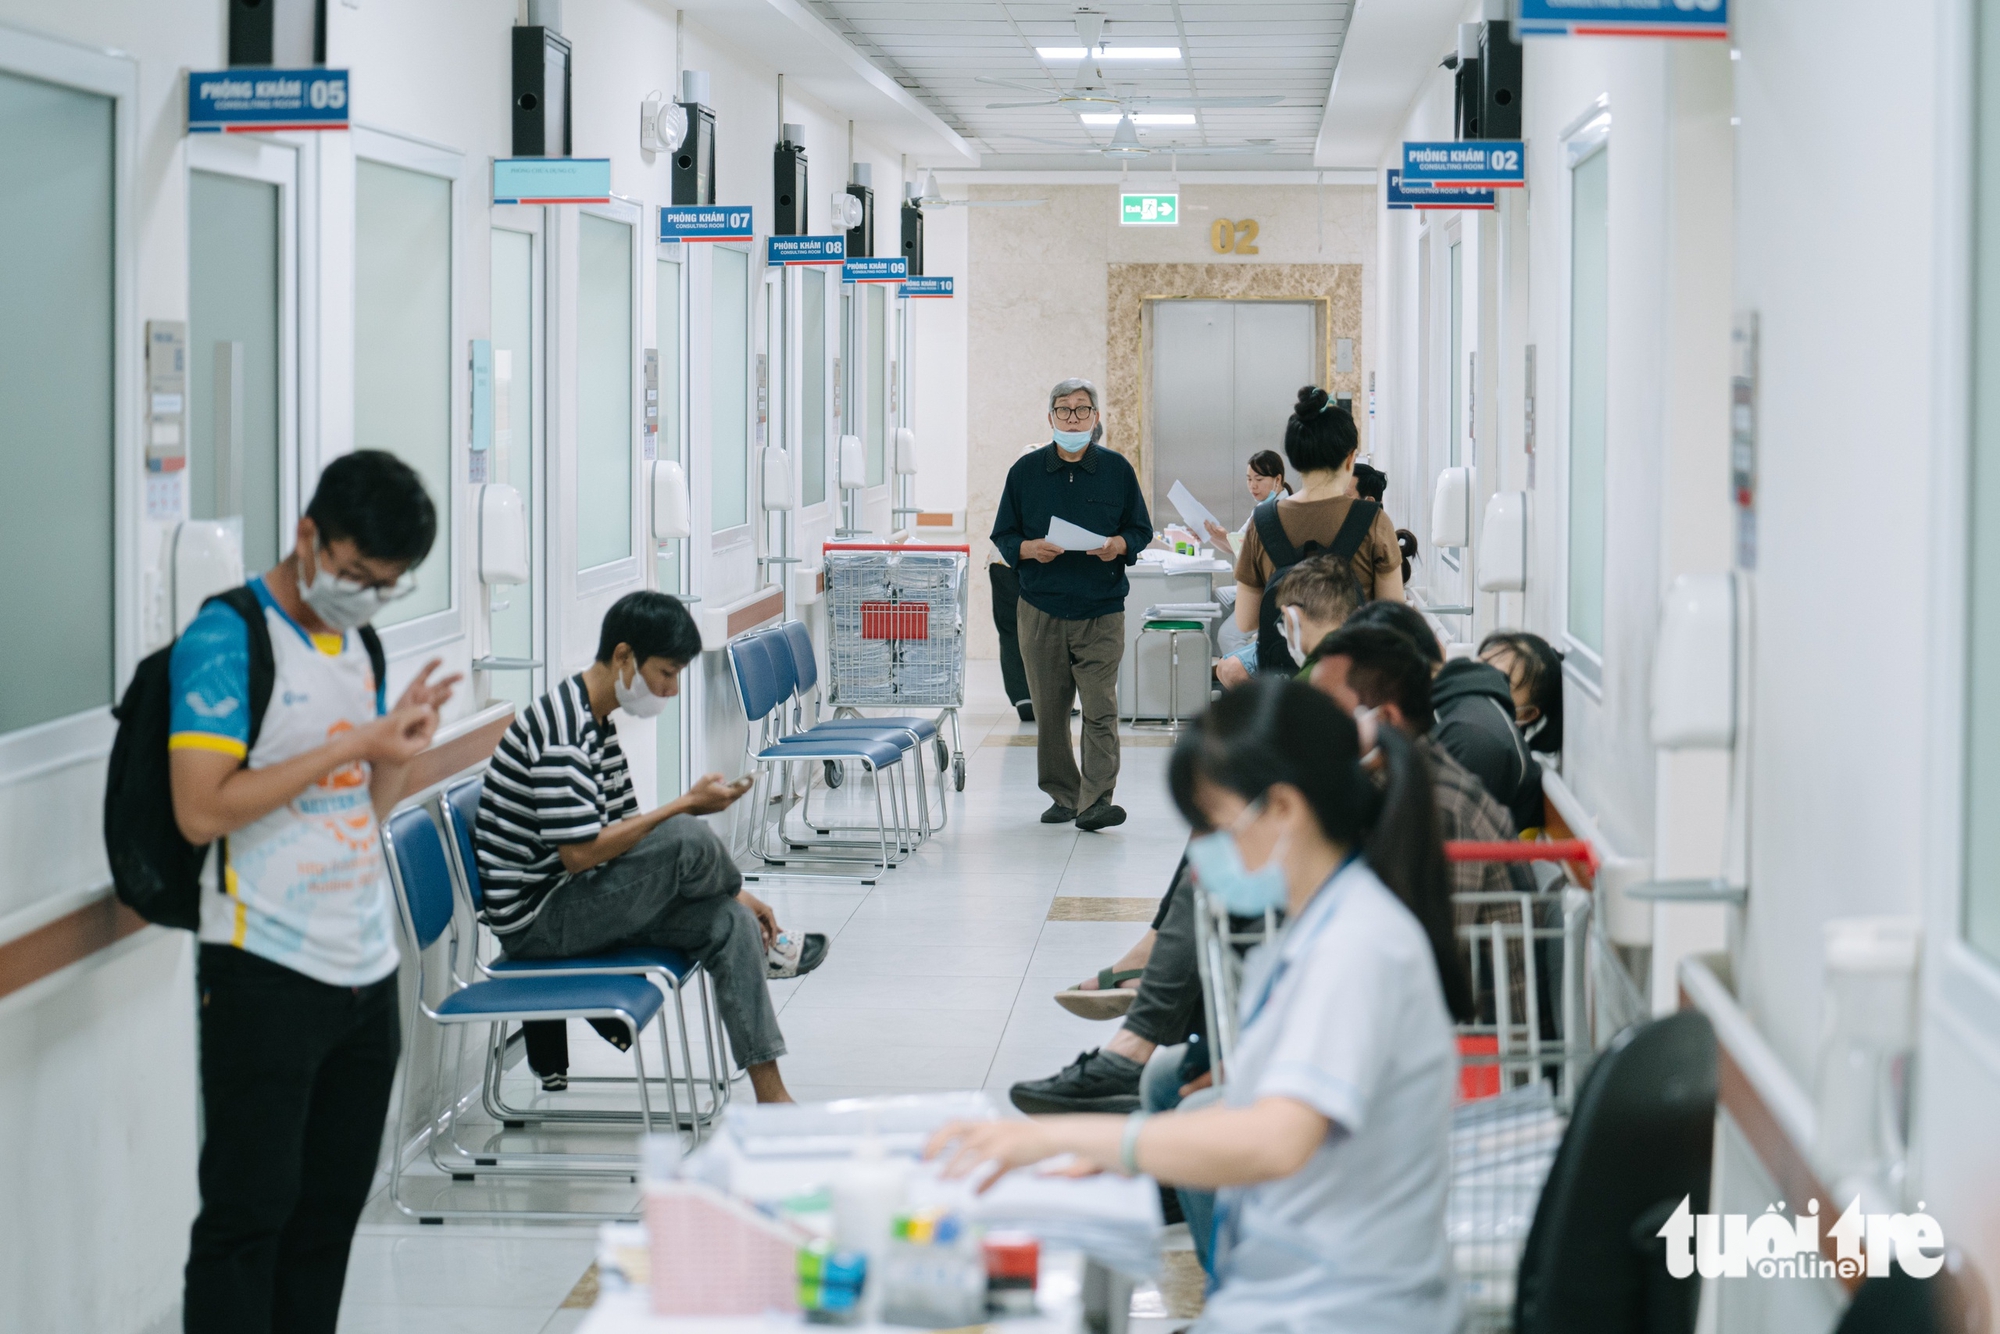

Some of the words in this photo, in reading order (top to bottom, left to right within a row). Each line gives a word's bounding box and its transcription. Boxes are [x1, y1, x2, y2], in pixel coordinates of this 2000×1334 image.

[310, 79, 346, 110] 05
[1409, 148, 1447, 162] PHÒNG
[1450, 148, 1484, 162] KHÁM
[1491, 150, 1518, 171] 02
[1419, 163, 1461, 171] CONSULTING
[668, 211, 697, 223] PHÒNG
[699, 211, 725, 222] KHÁM
[730, 212, 750, 228] 07
[1211, 218, 1260, 255] 02
[773, 240, 798, 250] PHÒNG
[800, 240, 821, 249] KHÁM
[825, 241, 842, 254] 08
[847, 262, 868, 270] PHÒNG
[869, 261, 887, 270] KHÁM
[890, 262, 905, 274] 09
[940, 280, 953, 291] 10
